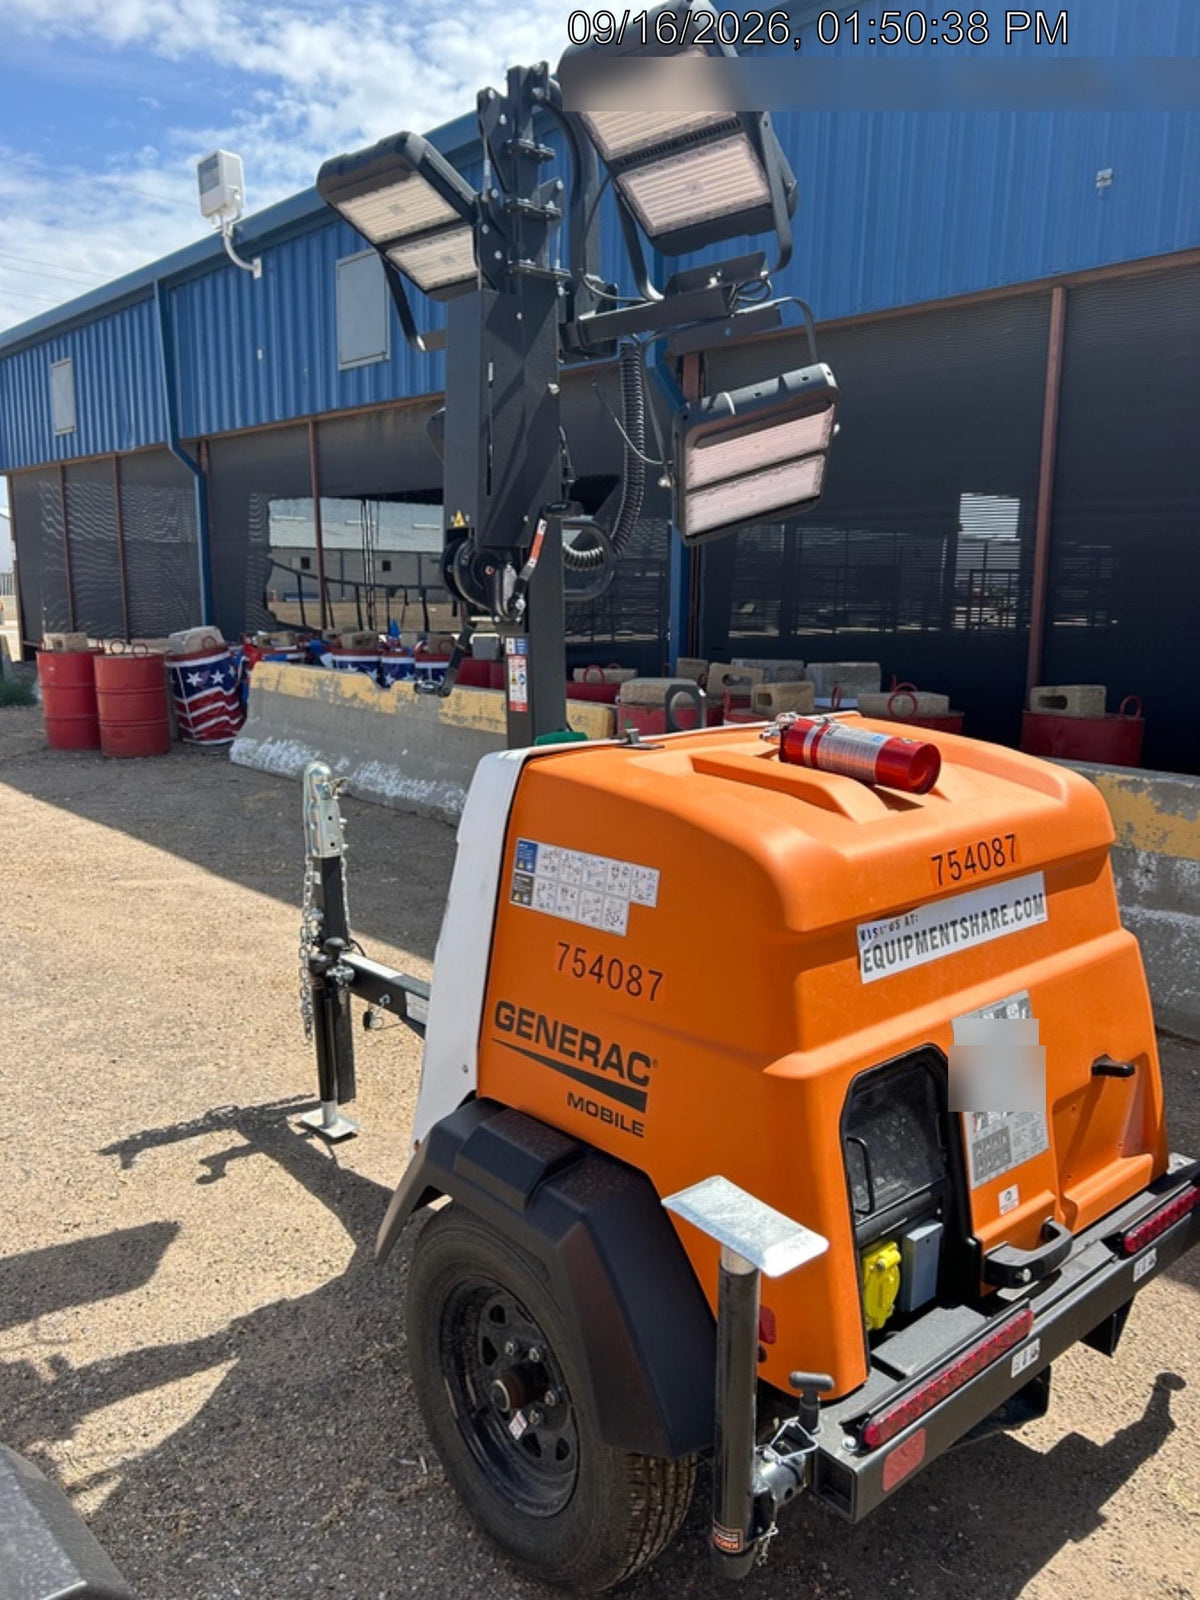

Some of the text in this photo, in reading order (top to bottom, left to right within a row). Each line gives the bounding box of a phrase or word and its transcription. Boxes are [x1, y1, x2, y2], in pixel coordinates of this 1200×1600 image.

[930, 833, 1017, 887] 754087
[862, 892, 1045, 974] EQUIPMENTSHARE.COM
[556, 941, 664, 1002] 754087
[494, 1000, 652, 1087] GENERAC
[566, 1091, 645, 1139] MOBILE
